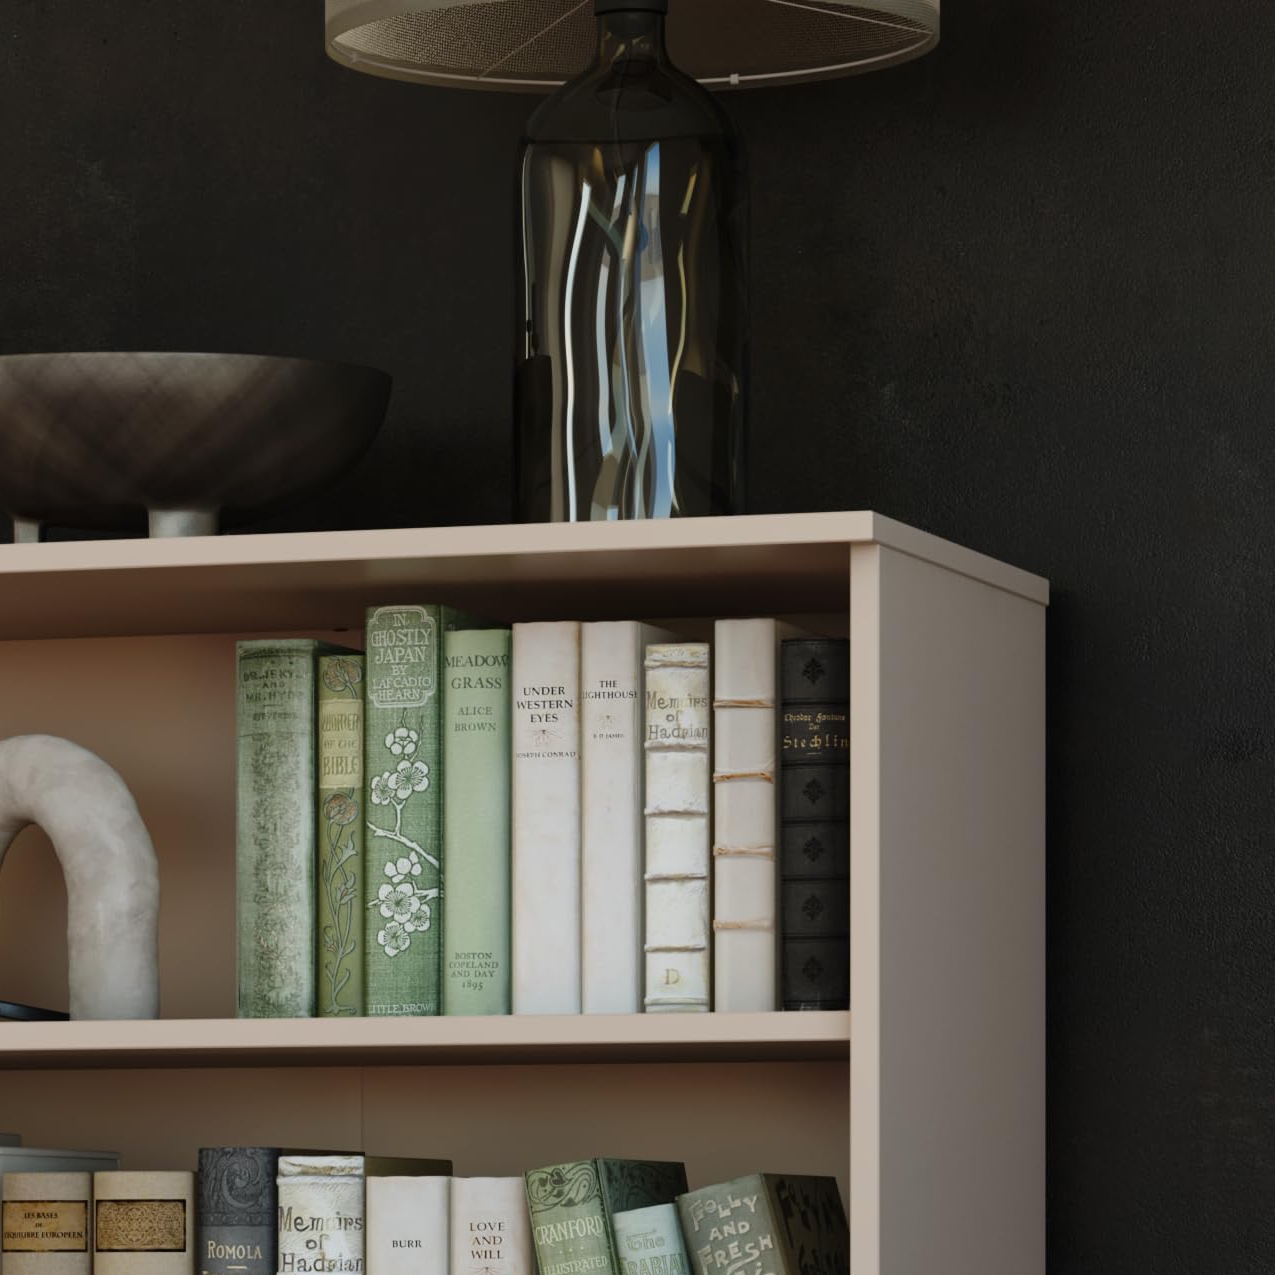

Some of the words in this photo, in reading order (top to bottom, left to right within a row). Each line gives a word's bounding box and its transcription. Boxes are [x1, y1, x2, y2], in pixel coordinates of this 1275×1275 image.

[371, 628, 431, 647] GHOSTLY
[375, 646, 427, 664] JAPAN
[444, 655, 509, 669] MEADOW
[391, 665, 407, 676] BY
[373, 676, 432, 690] LAFCADIO
[451, 676, 503, 690] GRASS
[598, 680, 618, 688] THE
[378, 689, 421, 701] HEARN
[523, 686, 566, 696] UNDER
[516, 699, 574, 710] WESTERN
[458, 706, 494, 716] ALICE
[530, 713, 559, 723] EYES
[454, 722, 498, 732] BROWN
[324, 755, 359, 776] BIBLE
[455, 952, 493, 960] BOSTON
[448, 961, 500, 969] COPELAND
[451, 970, 471, 978] AND
[474, 970, 496, 978] DAY
[664, 967, 681, 986] D
[462, 979, 484, 991] 1895
[689, 1195, 758, 1231] FOLLY
[469, 1222, 506, 1232] LOVE
[536, 1215, 604, 1247] CRANFORD
[708, 1221, 751, 1241] AND
[392, 1240, 423, 1248] BURR
[472, 1236, 504, 1246] AND
[207, 1241, 262, 1259] ROMOLA
[470, 1250, 505, 1260] WILL
